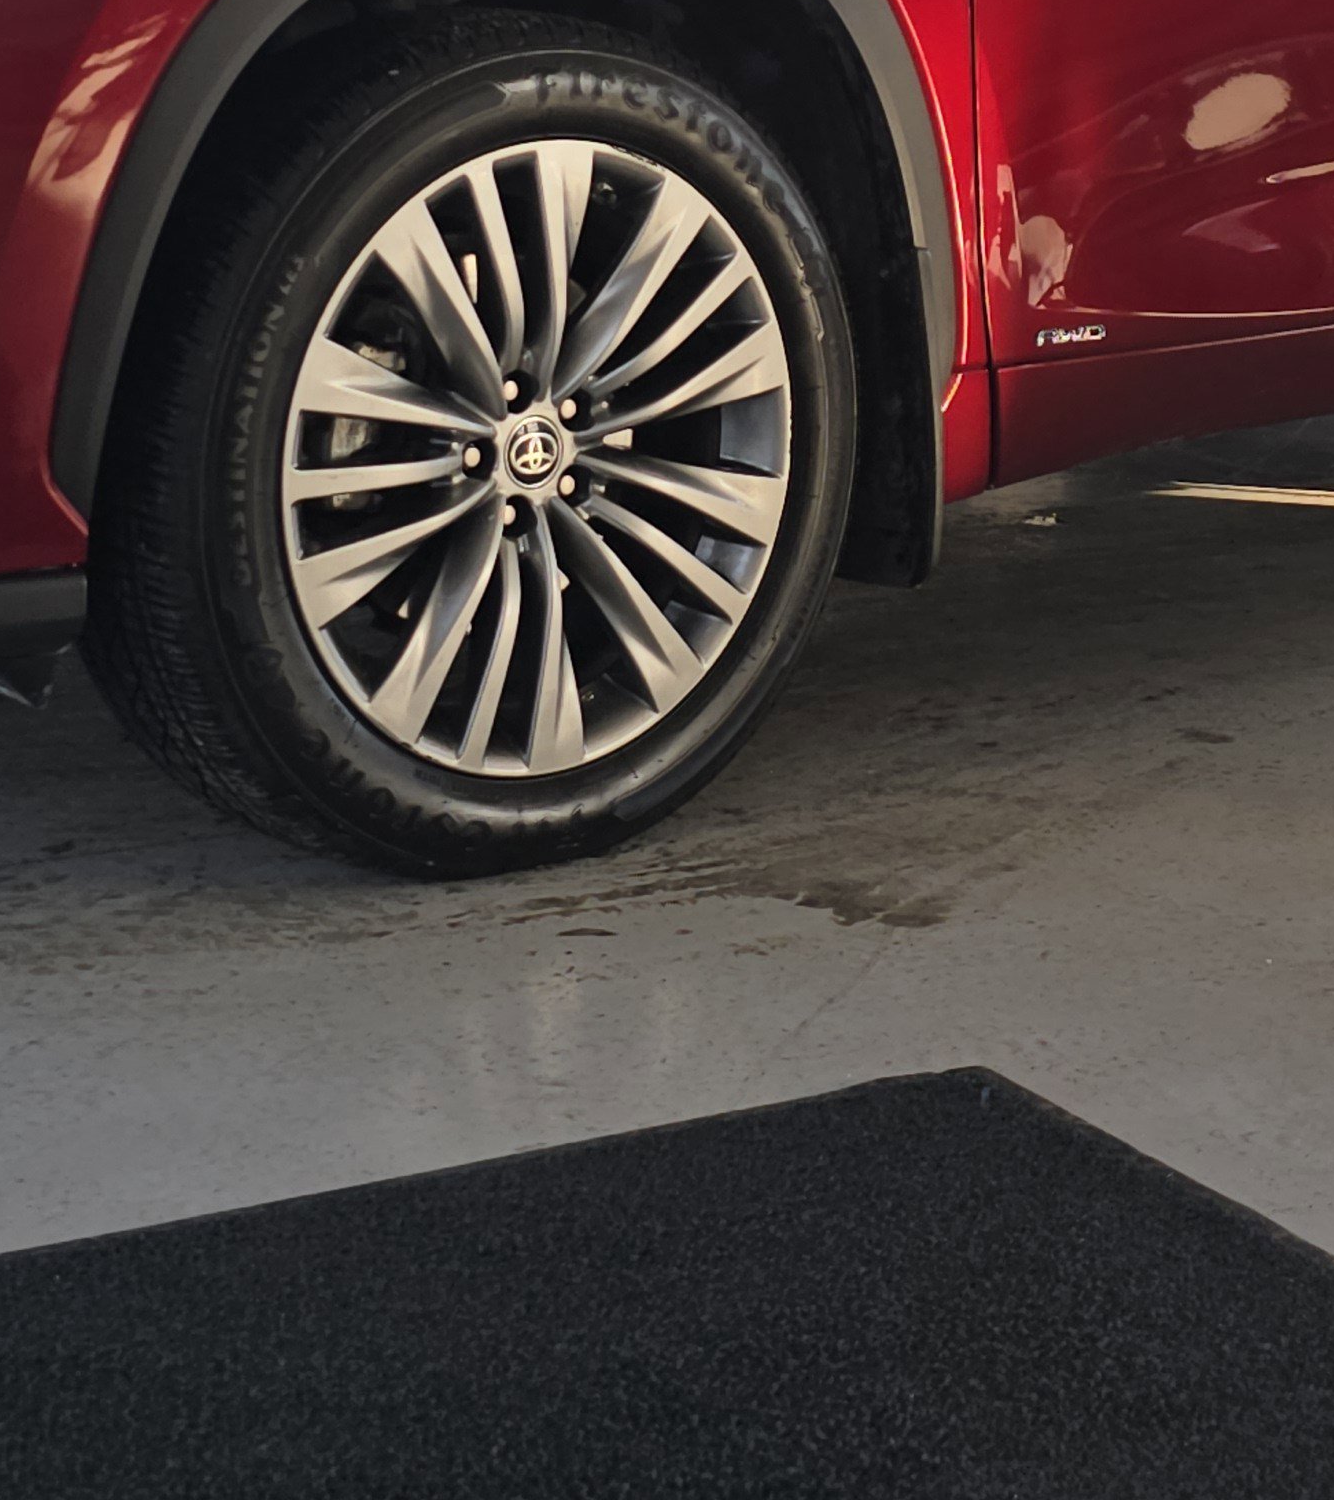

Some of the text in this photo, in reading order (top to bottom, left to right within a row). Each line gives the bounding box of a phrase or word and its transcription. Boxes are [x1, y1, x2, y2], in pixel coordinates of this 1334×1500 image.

[529, 65, 785, 216] Firestone
[1037, 324, 1106, 347] AWD
[229, 303, 285, 588] DESTINATION
